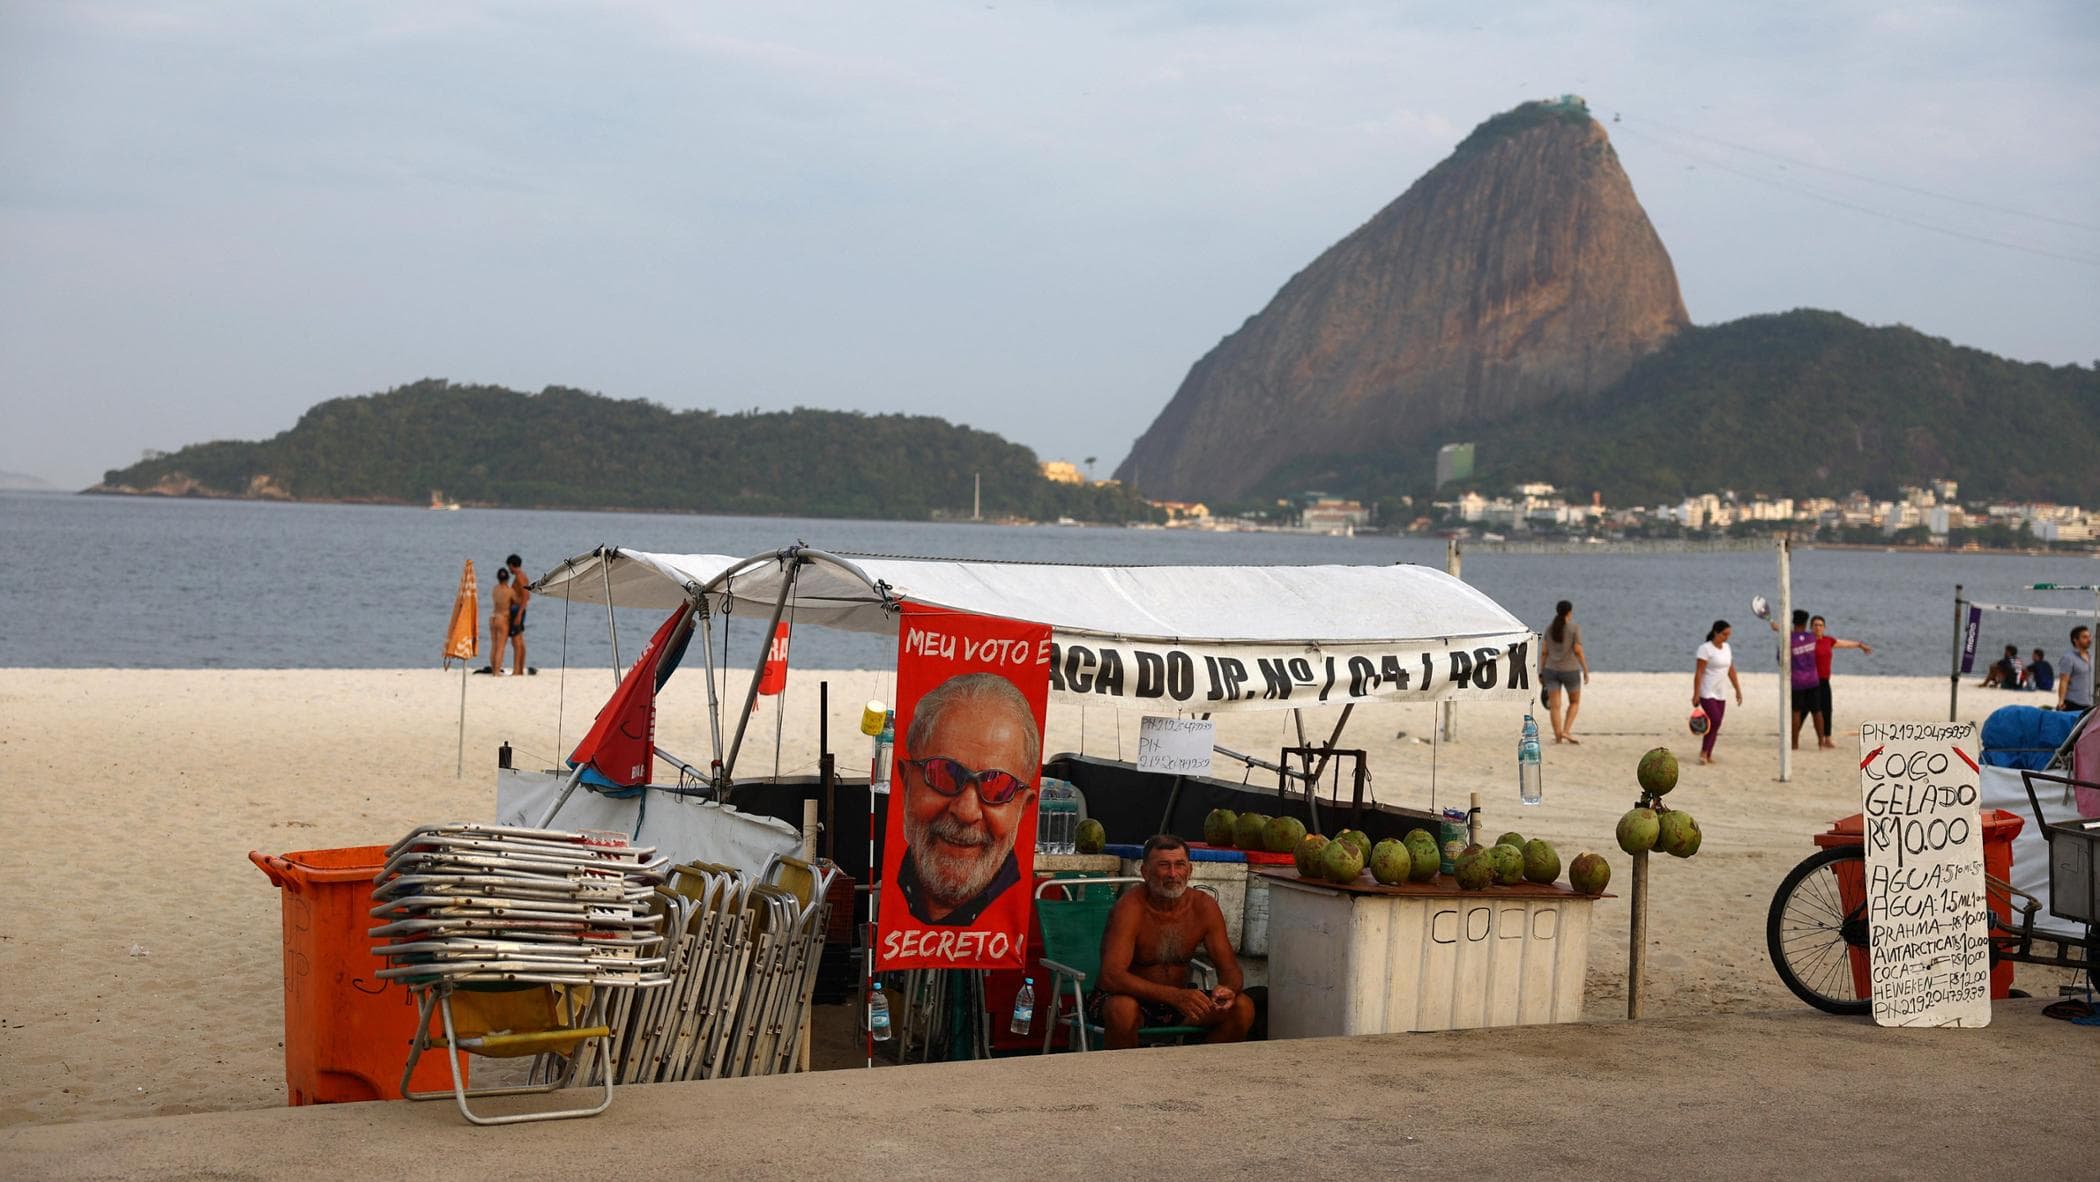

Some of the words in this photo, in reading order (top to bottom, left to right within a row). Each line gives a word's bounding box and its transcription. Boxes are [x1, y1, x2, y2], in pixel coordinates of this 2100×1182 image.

[905, 627, 956, 661] MEU
[964, 636, 1029, 666] VOTO
[1036, 631, 1050, 665] É
[1134, 650, 1195, 701] DO
[1866, 783, 1977, 816] GELADO
[1432, 907, 1557, 943] COCO
[1872, 919, 1940, 946] BRAHMA
[883, 930, 1009, 961] SECRETO
[1873, 935, 1952, 965] ANTARCTICA
[1873, 963, 1910, 983] COCA
